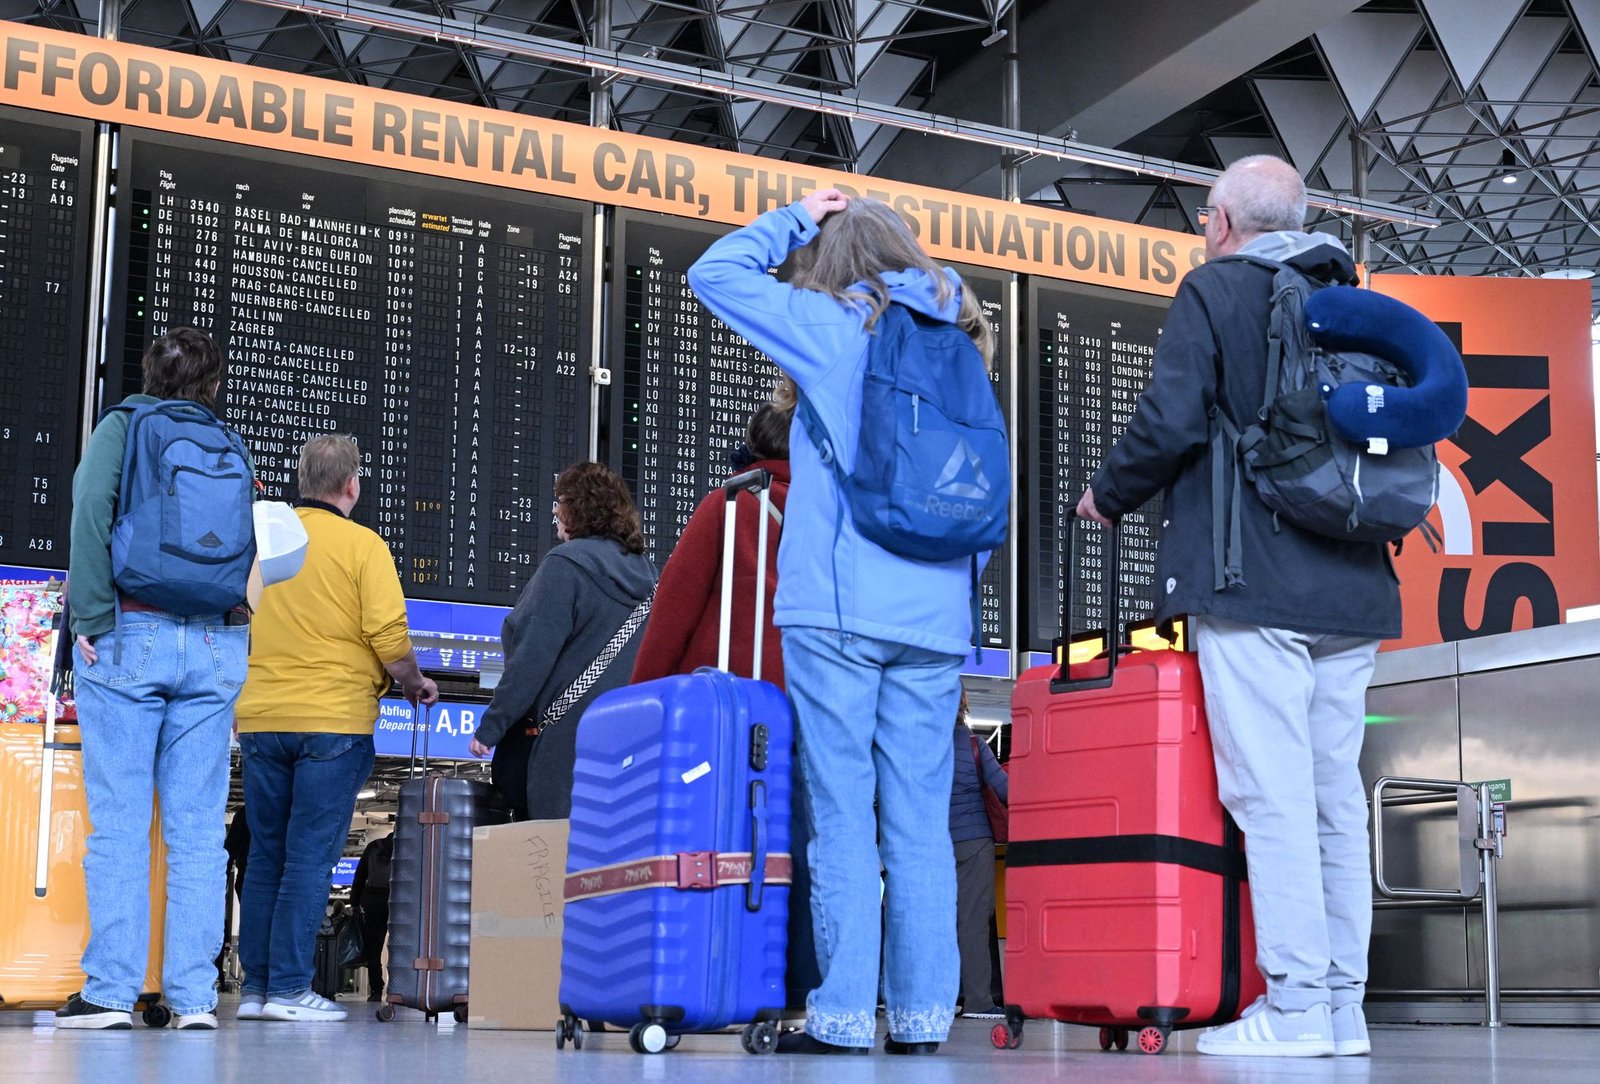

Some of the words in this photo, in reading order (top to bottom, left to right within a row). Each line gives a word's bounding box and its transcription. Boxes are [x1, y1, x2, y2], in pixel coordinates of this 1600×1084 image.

[4, 36, 355, 147] FFORDABLE
[371, 101, 577, 184] RENTAL
[593, 142, 710, 216] CAR,
[833, 183, 1126, 277] STINATION
[1139, 237, 1177, 284] IS
[160, 170, 172, 180] Flug
[52, 179, 65, 190] E4
[160, 180, 176, 190] Flight
[50, 194, 72, 206] A19
[160, 195, 173, 206] LH
[190, 200, 219, 213] 3540
[236, 206, 270, 221] BASEL
[280, 213, 380, 238] BAD-MANNHEIM-K
[560, 256, 571, 266] T7
[422, 222, 450, 231] estimated
[452, 226, 473, 234] Terminal
[422, 214, 447, 222] erwartet
[452, 216, 472, 226] Terminal
[507, 225, 520, 233] Zone
[559, 233, 581, 244] Flugsteig
[159, 209, 172, 220] DE
[191, 214, 218, 227] 1502
[235, 220, 270, 235] PALMA
[280, 227, 292, 238] DE
[302, 231, 358, 248] MALLORCA
[559, 270, 577, 281] A24
[649, 248, 659, 256] Flug
[157, 253, 170, 264] LH
[195, 258, 216, 270] 440
[158, 238, 171, 249] LH
[196, 244, 216, 256] 012
[234, 249, 357, 276] HAMBURG-CANCELLED
[158, 224, 172, 234] 6H
[196, 229, 217, 241] 276
[234, 235, 254, 247] TEL
[264, 240, 322, 256] AVIV-BEN
[330, 249, 372, 264] GURION
[559, 283, 570, 294] C6
[650, 256, 663, 265] Flight
[46, 282, 59, 293] T7
[156, 267, 170, 278] LH
[188, 272, 215, 284] 1394
[232, 278, 334, 301] PRAG-CANCELLED
[156, 282, 169, 292] LH
[195, 287, 214, 299] 142
[232, 292, 370, 320] NUERNBERG-CANCELLED
[649, 296, 660, 306] LH
[681, 301, 698, 312] 802
[648, 310, 660, 320] LH
[675, 314, 698, 325] 1558
[1058, 312, 1066, 320] Flug
[155, 296, 168, 307] LH
[194, 302, 214, 313] 880
[232, 306, 282, 322] TALLINN
[505, 344, 535, 356] 12-13
[557, 351, 575, 362] A16
[674, 327, 697, 338] 2106
[154, 311, 168, 322] OU
[193, 316, 213, 327] 417
[230, 321, 274, 336] ZAGREB
[556, 365, 575, 376] A22
[648, 336, 659, 346] LH
[680, 341, 697, 351] 334
[1059, 333, 1068, 342] LH
[1080, 336, 1100, 347] 3410
[229, 336, 354, 360] ATLANTA-CANCELLED
[1058, 346, 1068, 354] AA
[1086, 349, 1100, 359] 071
[229, 350, 338, 372] KAIRO-CANCELLED
[648, 350, 659, 359] LH
[674, 353, 696, 364] 1054
[1059, 357, 1068, 366] BA
[1086, 362, 1100, 371] 903
[228, 364, 367, 390] KOPENHAGE-CANCELLED
[647, 363, 658, 372] LH
[674, 366, 696, 378] 1410
[647, 376, 658, 386] LH
[679, 380, 696, 391] 978
[1059, 370, 1067, 378] EI
[1086, 374, 1100, 383] 651
[1112, 378, 1143, 390] DUBLIN
[228, 379, 366, 404] STAVANGER-CANCELLED
[1059, 382, 1068, 391] LH
[1086, 386, 1100, 396] 400
[1112, 390, 1127, 399] NEW
[679, 394, 696, 404] 382
[1059, 394, 1068, 403] LH
[1082, 398, 1100, 408] 1128
[226, 408, 336, 430] SOFIA-CANCELLED
[646, 403, 658, 413] XQ
[679, 407, 695, 417] 911
[712, 411, 740, 423] IZMIR
[1059, 406, 1068, 416] UX
[1082, 410, 1100, 420] 1502
[646, 416, 657, 426] DL
[679, 420, 696, 431] 015
[1058, 418, 1068, 428] DL
[1086, 422, 1100, 432] 087
[36, 432, 49, 443] A1
[646, 430, 657, 440] LH
[678, 434, 695, 444] 232
[1059, 431, 1068, 440] LH
[1082, 434, 1100, 444] 1356
[646, 444, 657, 453] LH
[678, 448, 695, 458] 448
[34, 478, 47, 489] T5
[645, 470, 656, 480] LH
[672, 474, 694, 484] 1364
[1434, 321, 1560, 643] SIXT
[33, 493, 46, 504] T6
[924, 494, 992, 522] Reebo
[500, 510, 530, 522] 12-13
[29, 539, 52, 550] A28
[498, 552, 529, 564] 12-13
[1081, 570, 1101, 580] 3648
[983, 585, 993, 594] T5
[1086, 583, 1101, 592] 206
[983, 598, 998, 607] A40
[983, 610, 998, 620] Z66
[983, 623, 998, 633] B46
[380, 704, 412, 719] Abflug
[522, 835, 555, 930] FRAGILE
